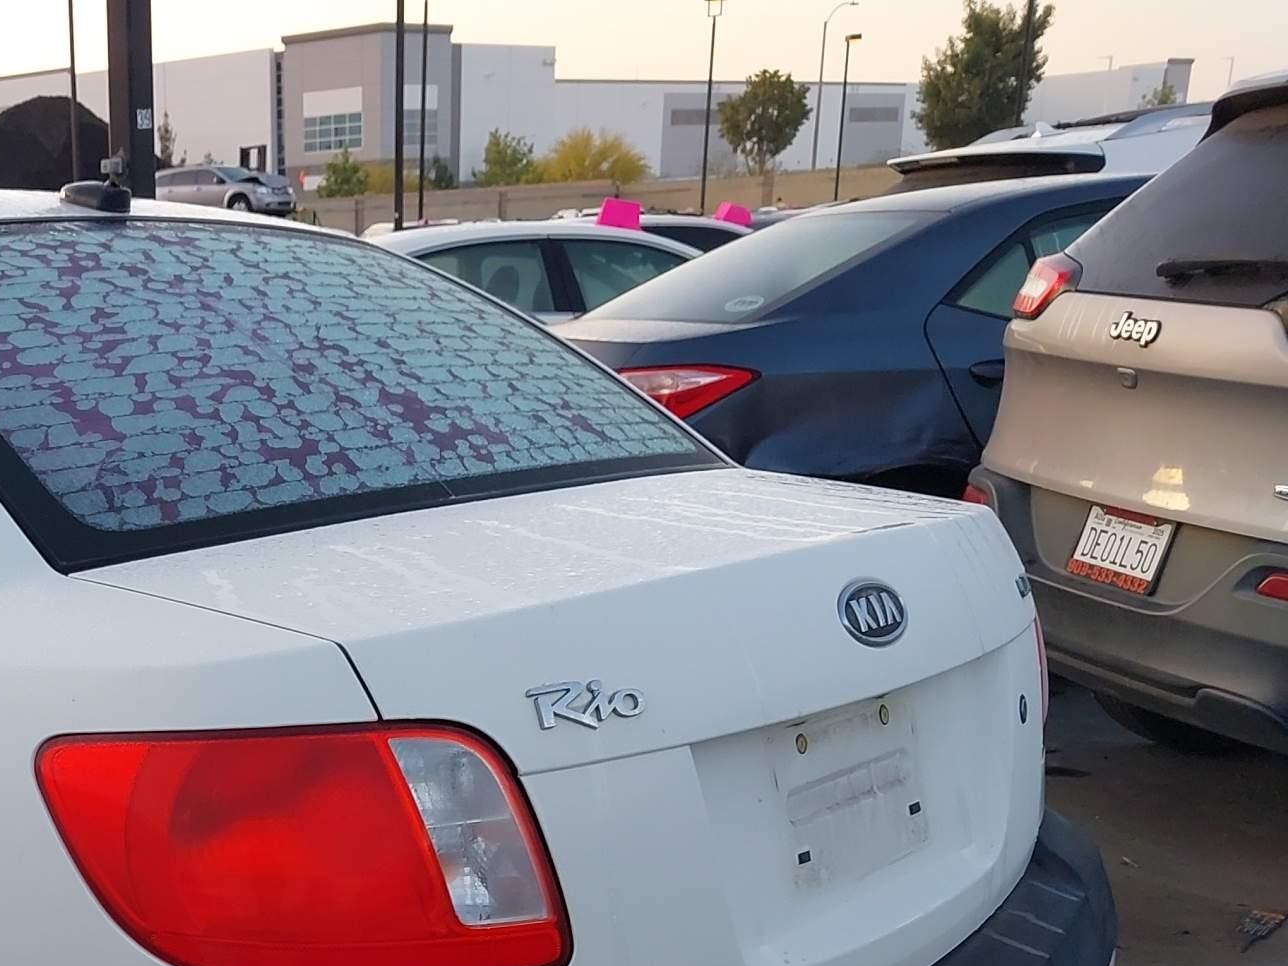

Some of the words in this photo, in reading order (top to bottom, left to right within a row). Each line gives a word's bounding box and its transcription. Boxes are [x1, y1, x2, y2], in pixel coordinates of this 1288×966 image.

[1110, 311, 1161, 347] Jeep
[848, 591, 902, 633] KIA
[525, 679, 647, 730] Rio
